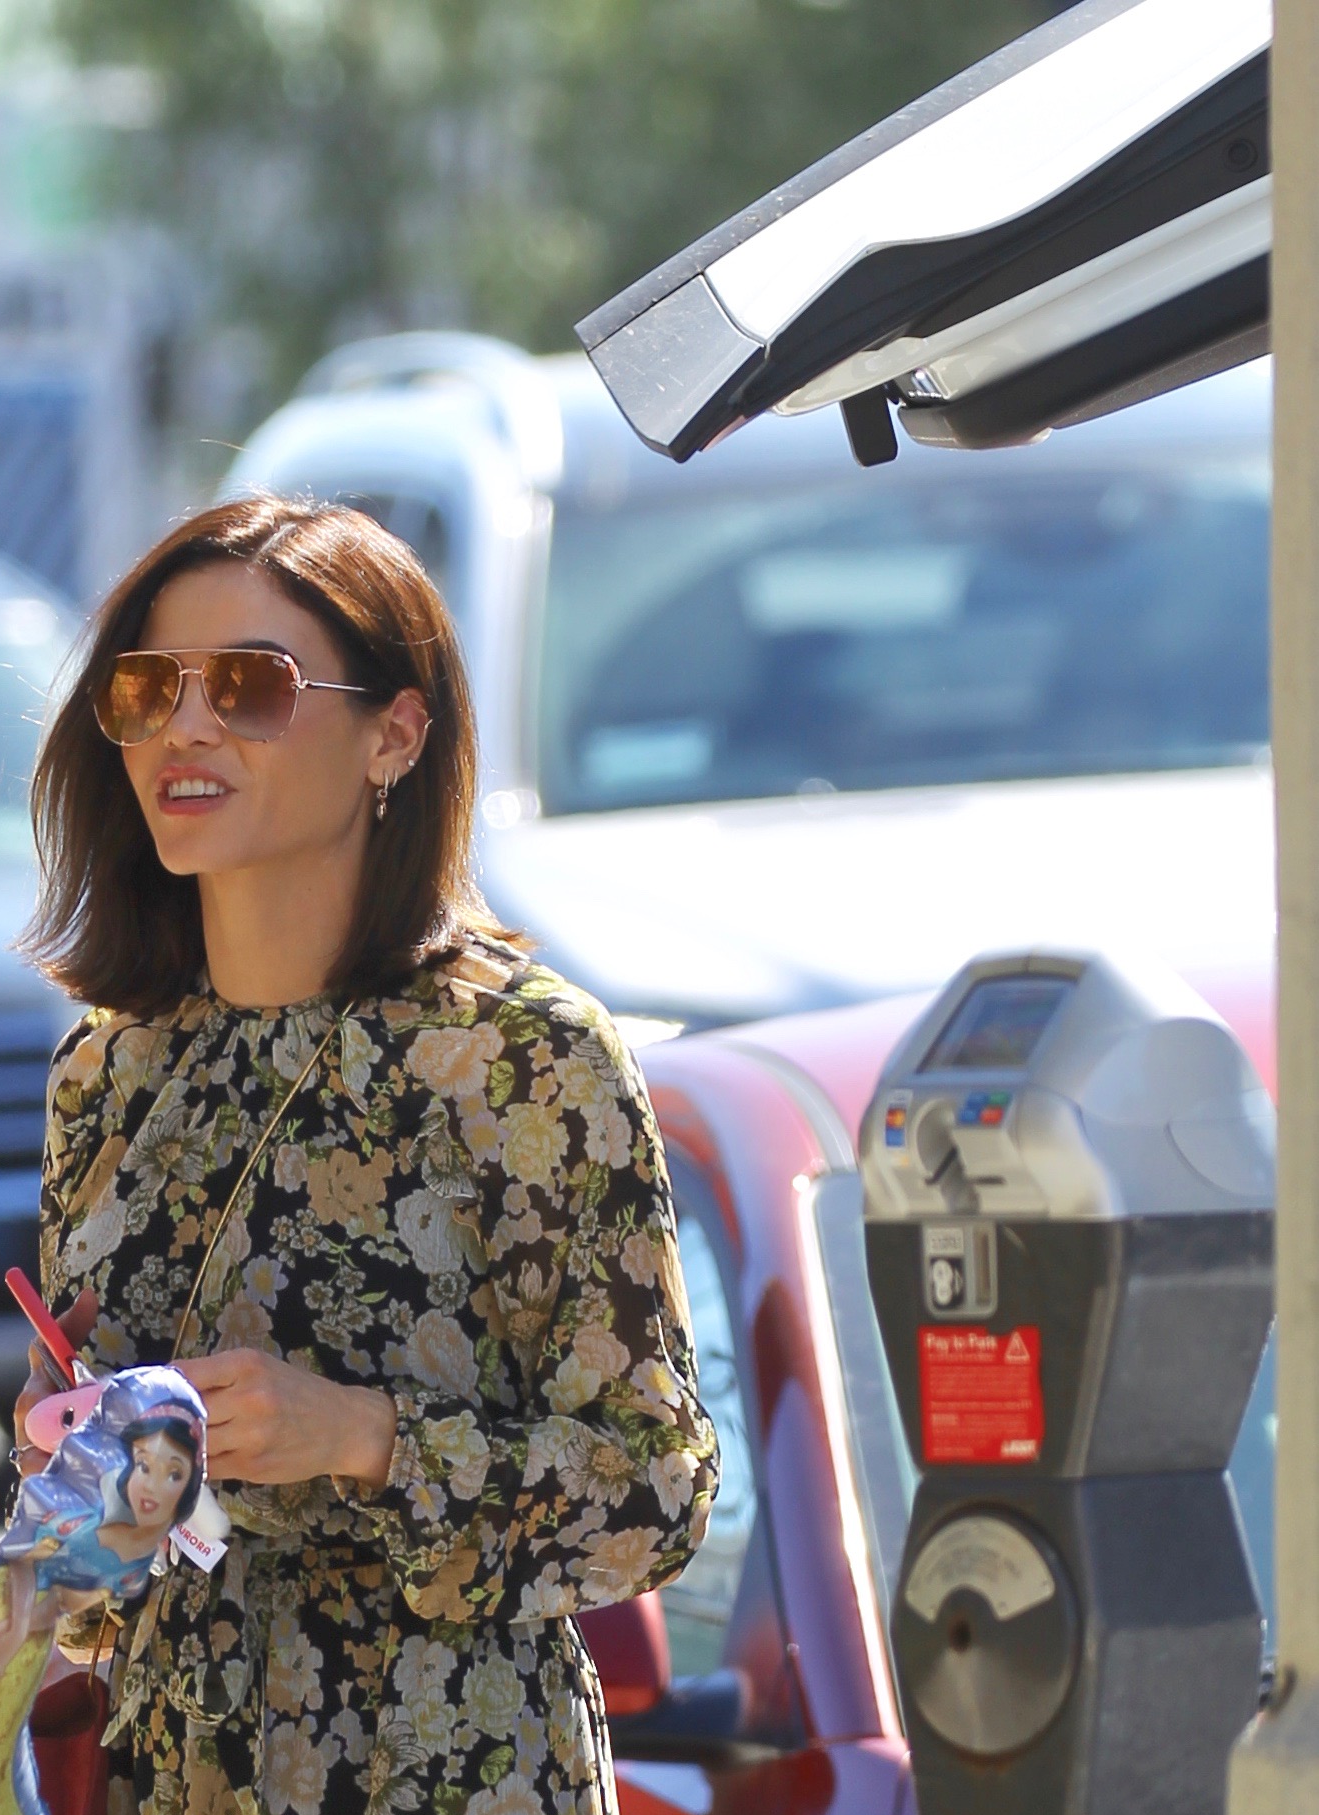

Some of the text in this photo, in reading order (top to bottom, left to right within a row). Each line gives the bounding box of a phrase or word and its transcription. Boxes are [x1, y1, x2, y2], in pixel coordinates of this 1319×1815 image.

[925, 1332, 998, 1355] Pay to Park
